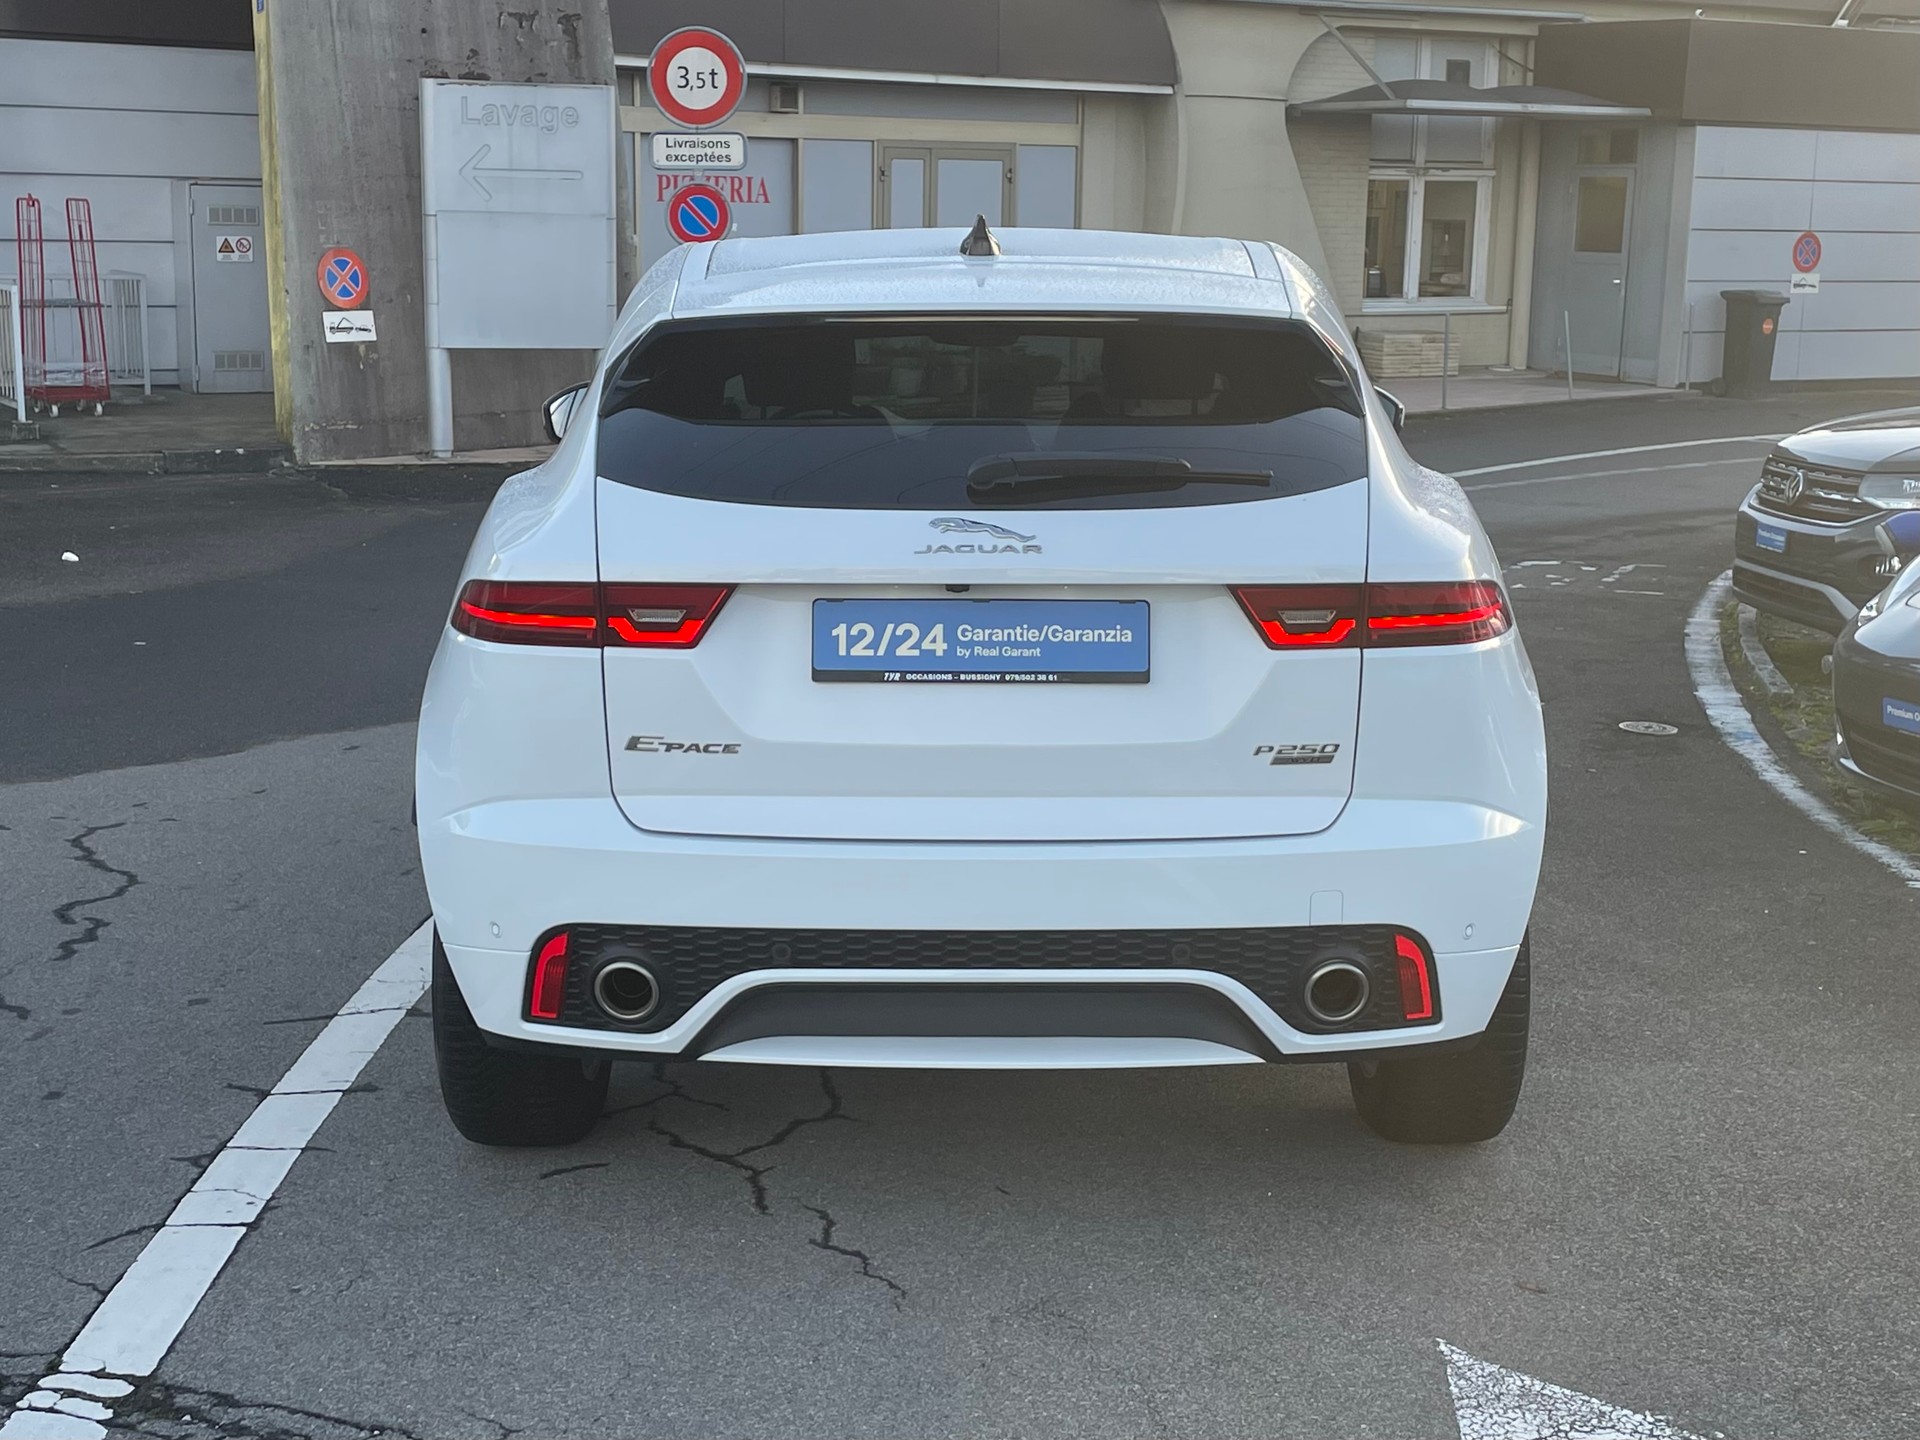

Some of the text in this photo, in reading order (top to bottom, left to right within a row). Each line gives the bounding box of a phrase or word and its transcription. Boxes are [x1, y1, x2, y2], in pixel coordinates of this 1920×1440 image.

[461, 95, 579, 134] Lavage
[665, 137, 731, 149] Livraisons
[665, 151, 732, 164] exceptées
[913, 544, 1043, 555] JAGUAR
[831, 622, 948, 657] 12/24
[956, 624, 1133, 643] Garantie/Garanzia
[956, 646, 1041, 659] by Real Garant
[905, 673, 953, 681] OCCASIONS
[1253, 743, 1340, 756] P250
